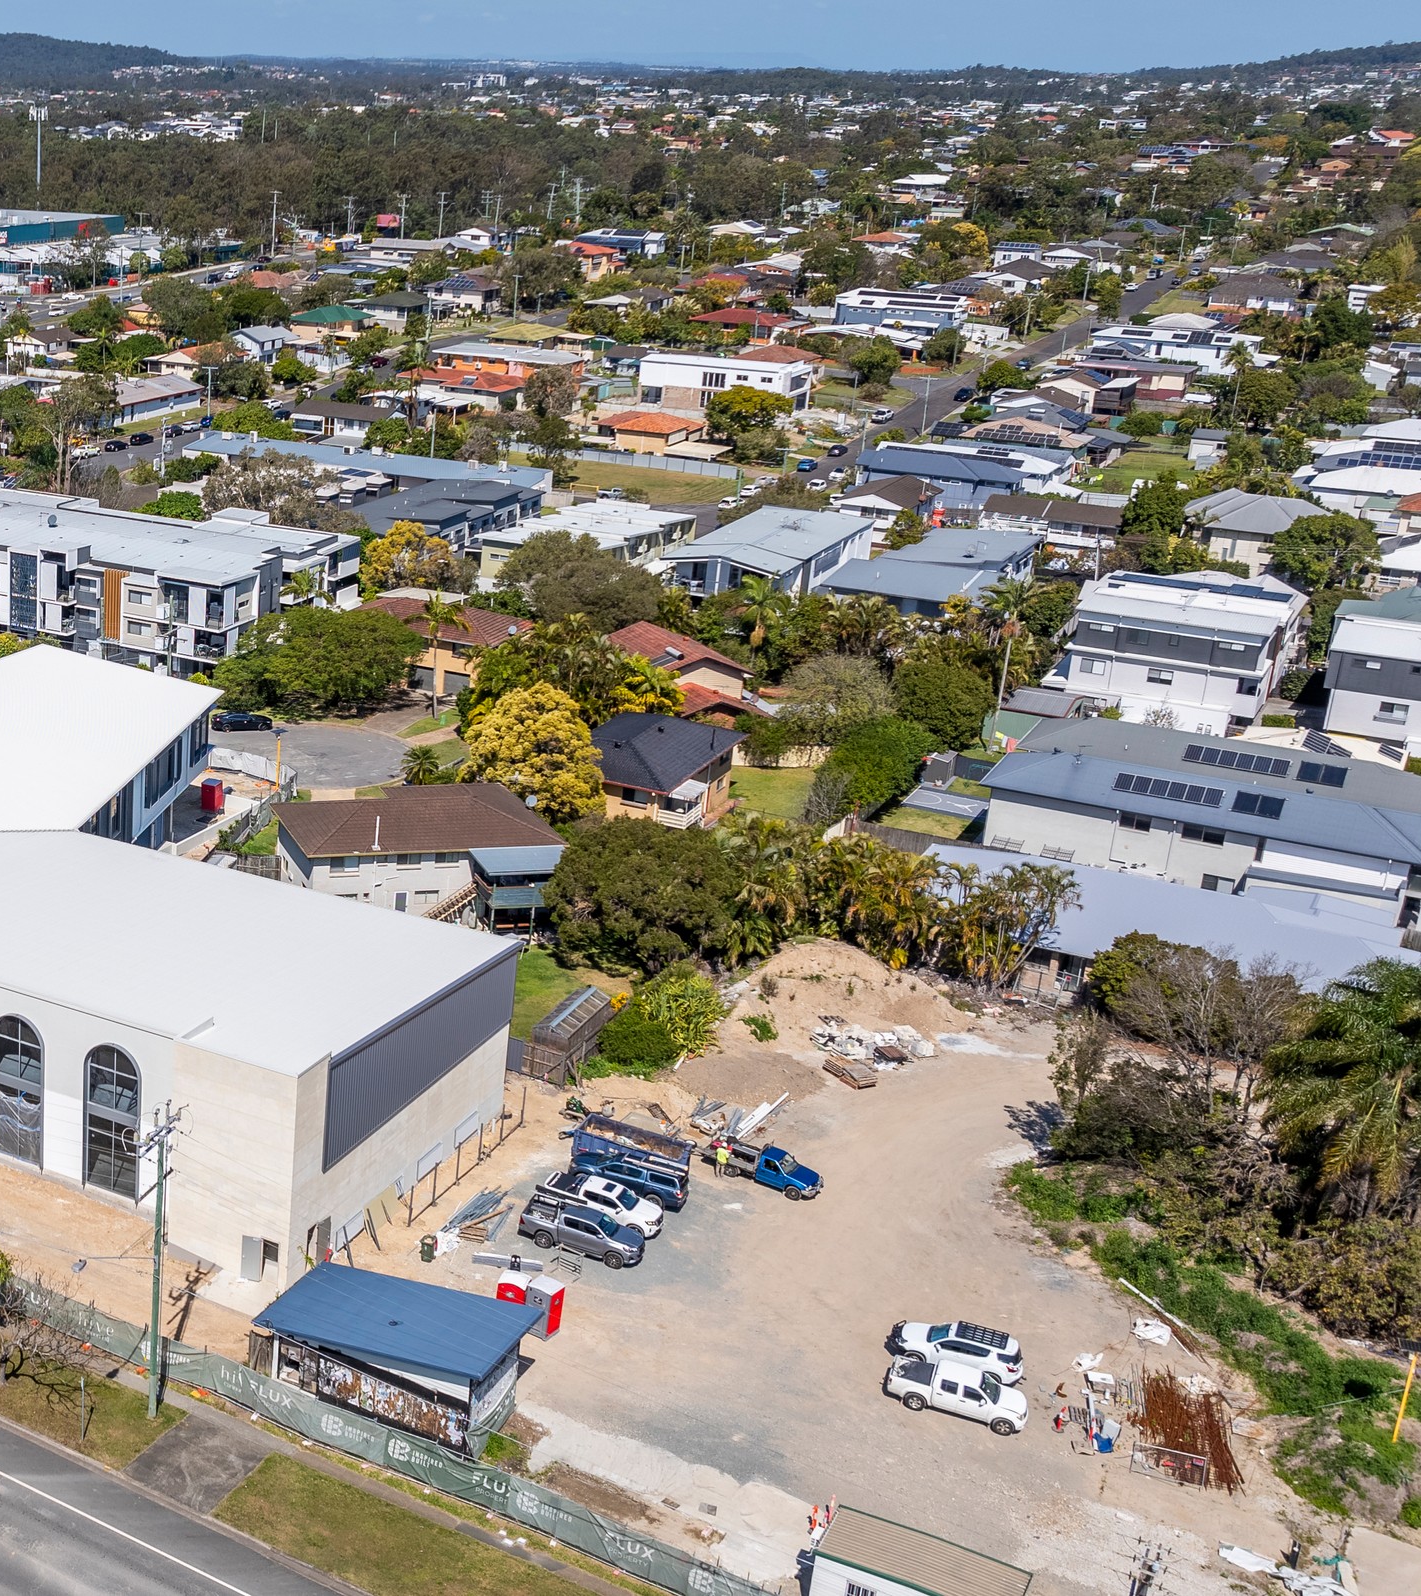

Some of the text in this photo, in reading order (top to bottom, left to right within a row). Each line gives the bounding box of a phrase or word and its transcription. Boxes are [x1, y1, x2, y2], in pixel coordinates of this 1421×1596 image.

[344, 1430, 363, 1442] BUILT
[345, 1425, 375, 1442] INSPIRED
[411, 1456, 431, 1469] BUILT
[412, 1450, 443, 1469] INSPIRED
[540, 1508, 558, 1522] BUILT
[541, 1503, 573, 1523] INSPIRED
